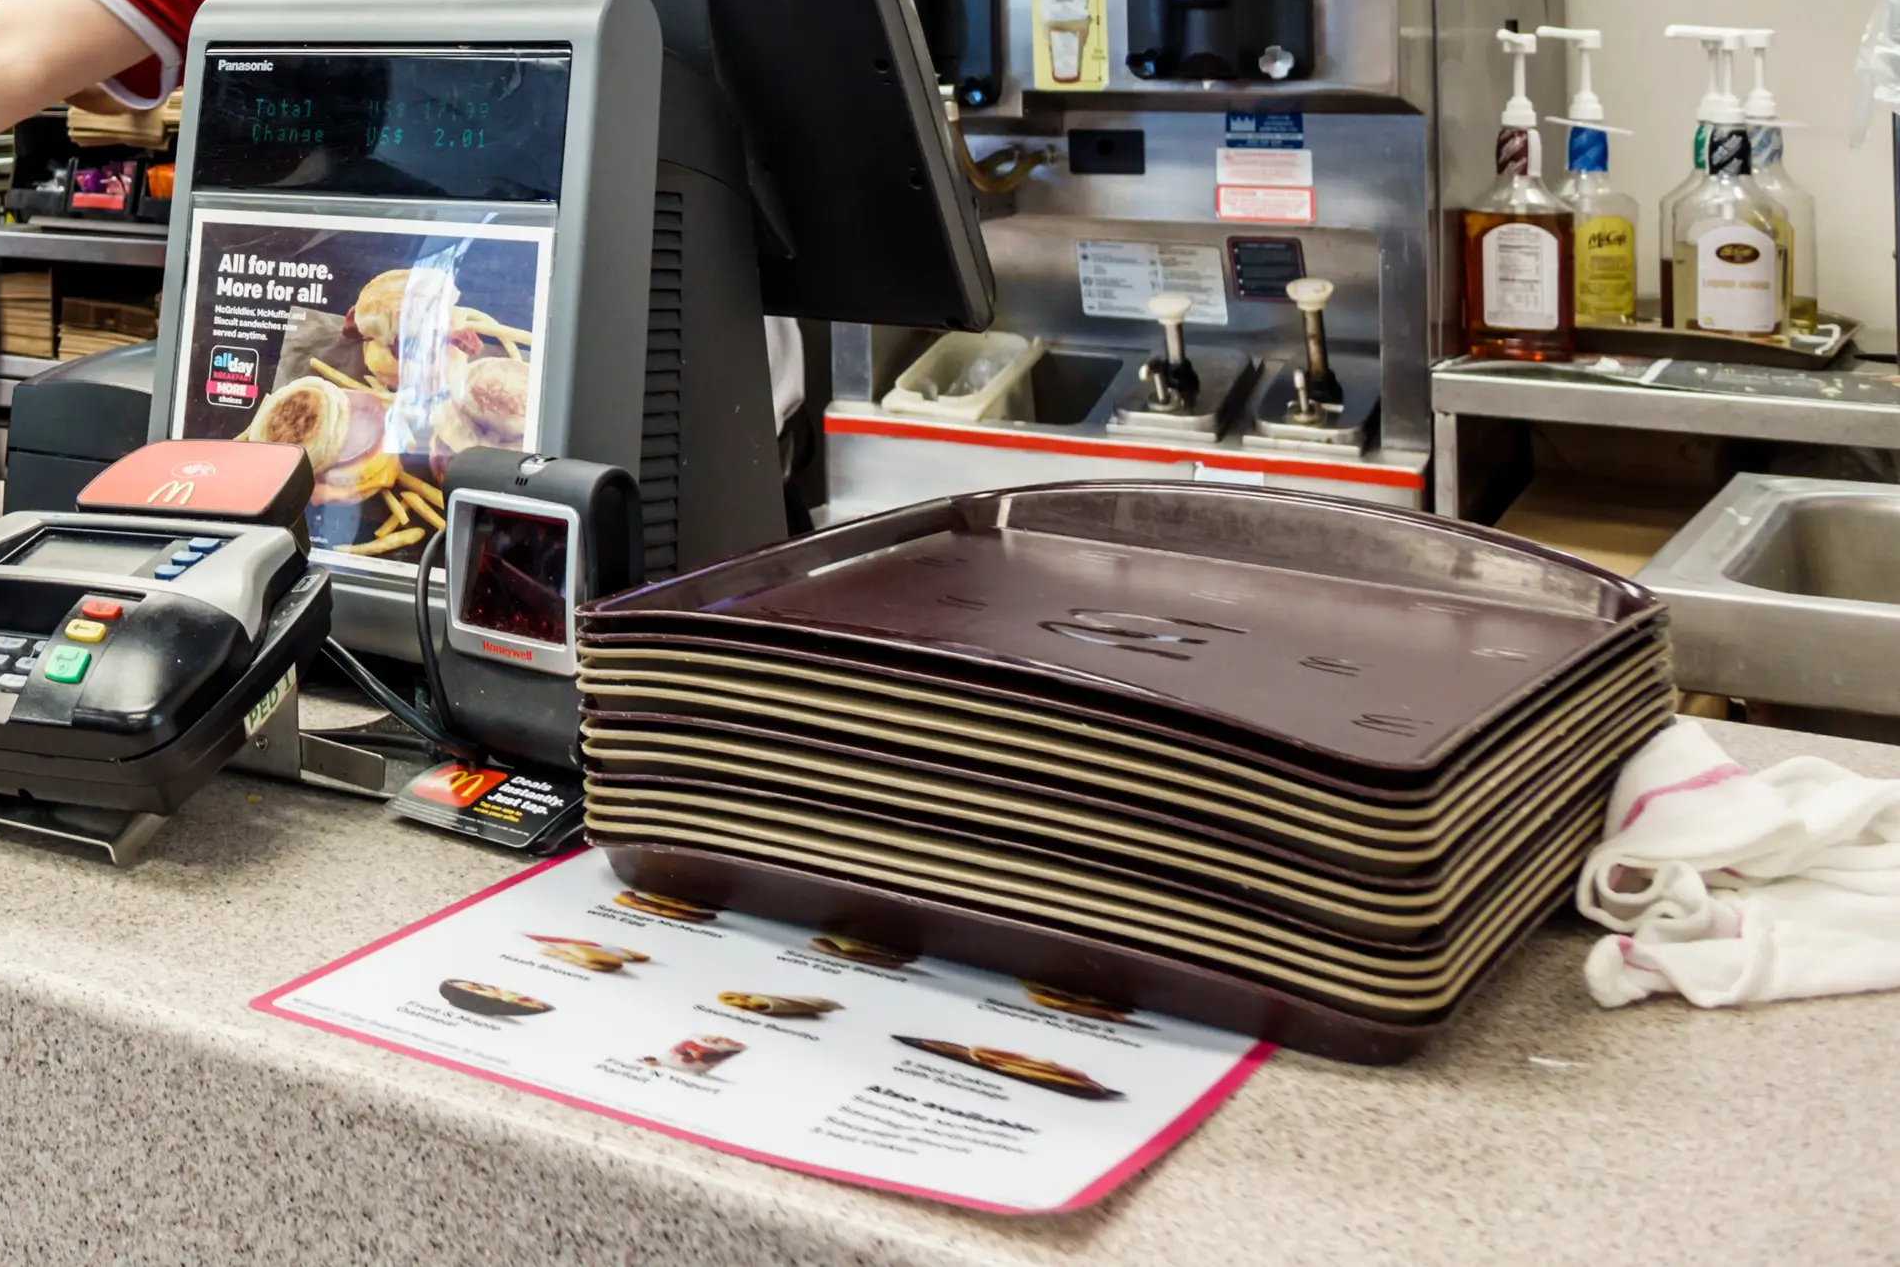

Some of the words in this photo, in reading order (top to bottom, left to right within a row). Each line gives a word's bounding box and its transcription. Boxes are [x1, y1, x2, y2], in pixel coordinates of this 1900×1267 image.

[218, 59, 274, 72] Panasonic
[256, 98, 312, 118] Total
[252, 124, 324, 144] Change
[366, 127, 403, 146] US$
[434, 128, 485, 148] 2.01
[218, 254, 245, 274] All
[248, 255, 275, 277] for
[279, 260, 334, 280] more.
[216, 277, 263, 299] More
[266, 280, 294, 301] for
[297, 283, 328, 304] all.
[214, 316, 239, 327] Biscuit
[239, 319, 282, 331] sandwiches
[213, 328, 237, 338] served
[237, 330, 268, 341] anytime.
[217, 382, 247, 396] MORE
[483, 640, 532, 661] Honeywell
[248, 685, 280, 730] PED
[510, 775, 553, 792] Deals
[487, 793, 521, 808] Just
[520, 800, 548, 815] tap.
[498, 783, 564, 807] instantly.
[595, 904, 654, 923] Sausage
[499, 953, 535, 967] Hash
[538, 964, 591, 981] Browns
[865, 1085, 917, 1103] Also
